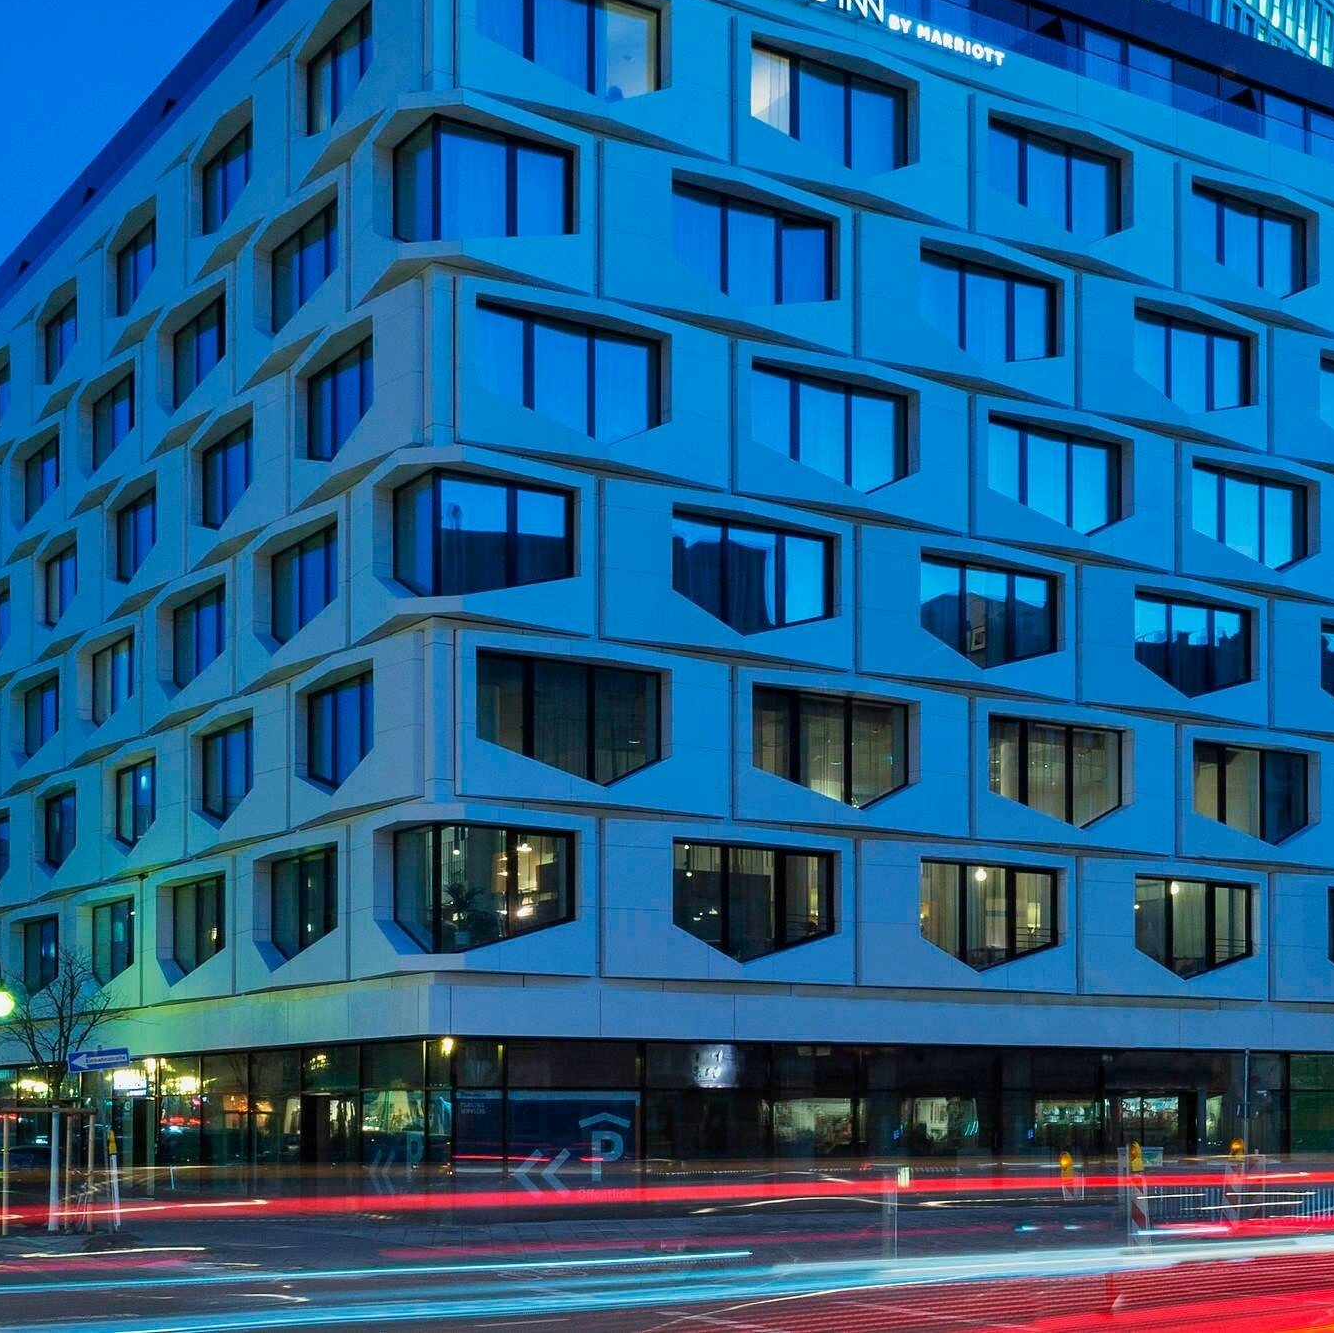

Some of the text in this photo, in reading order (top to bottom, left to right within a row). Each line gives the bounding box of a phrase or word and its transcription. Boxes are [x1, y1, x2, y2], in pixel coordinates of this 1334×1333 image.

[888, 13, 912, 34] BY
[916, 23, 1005, 66] MARRIOTT
[591, 1130, 625, 1182] P
